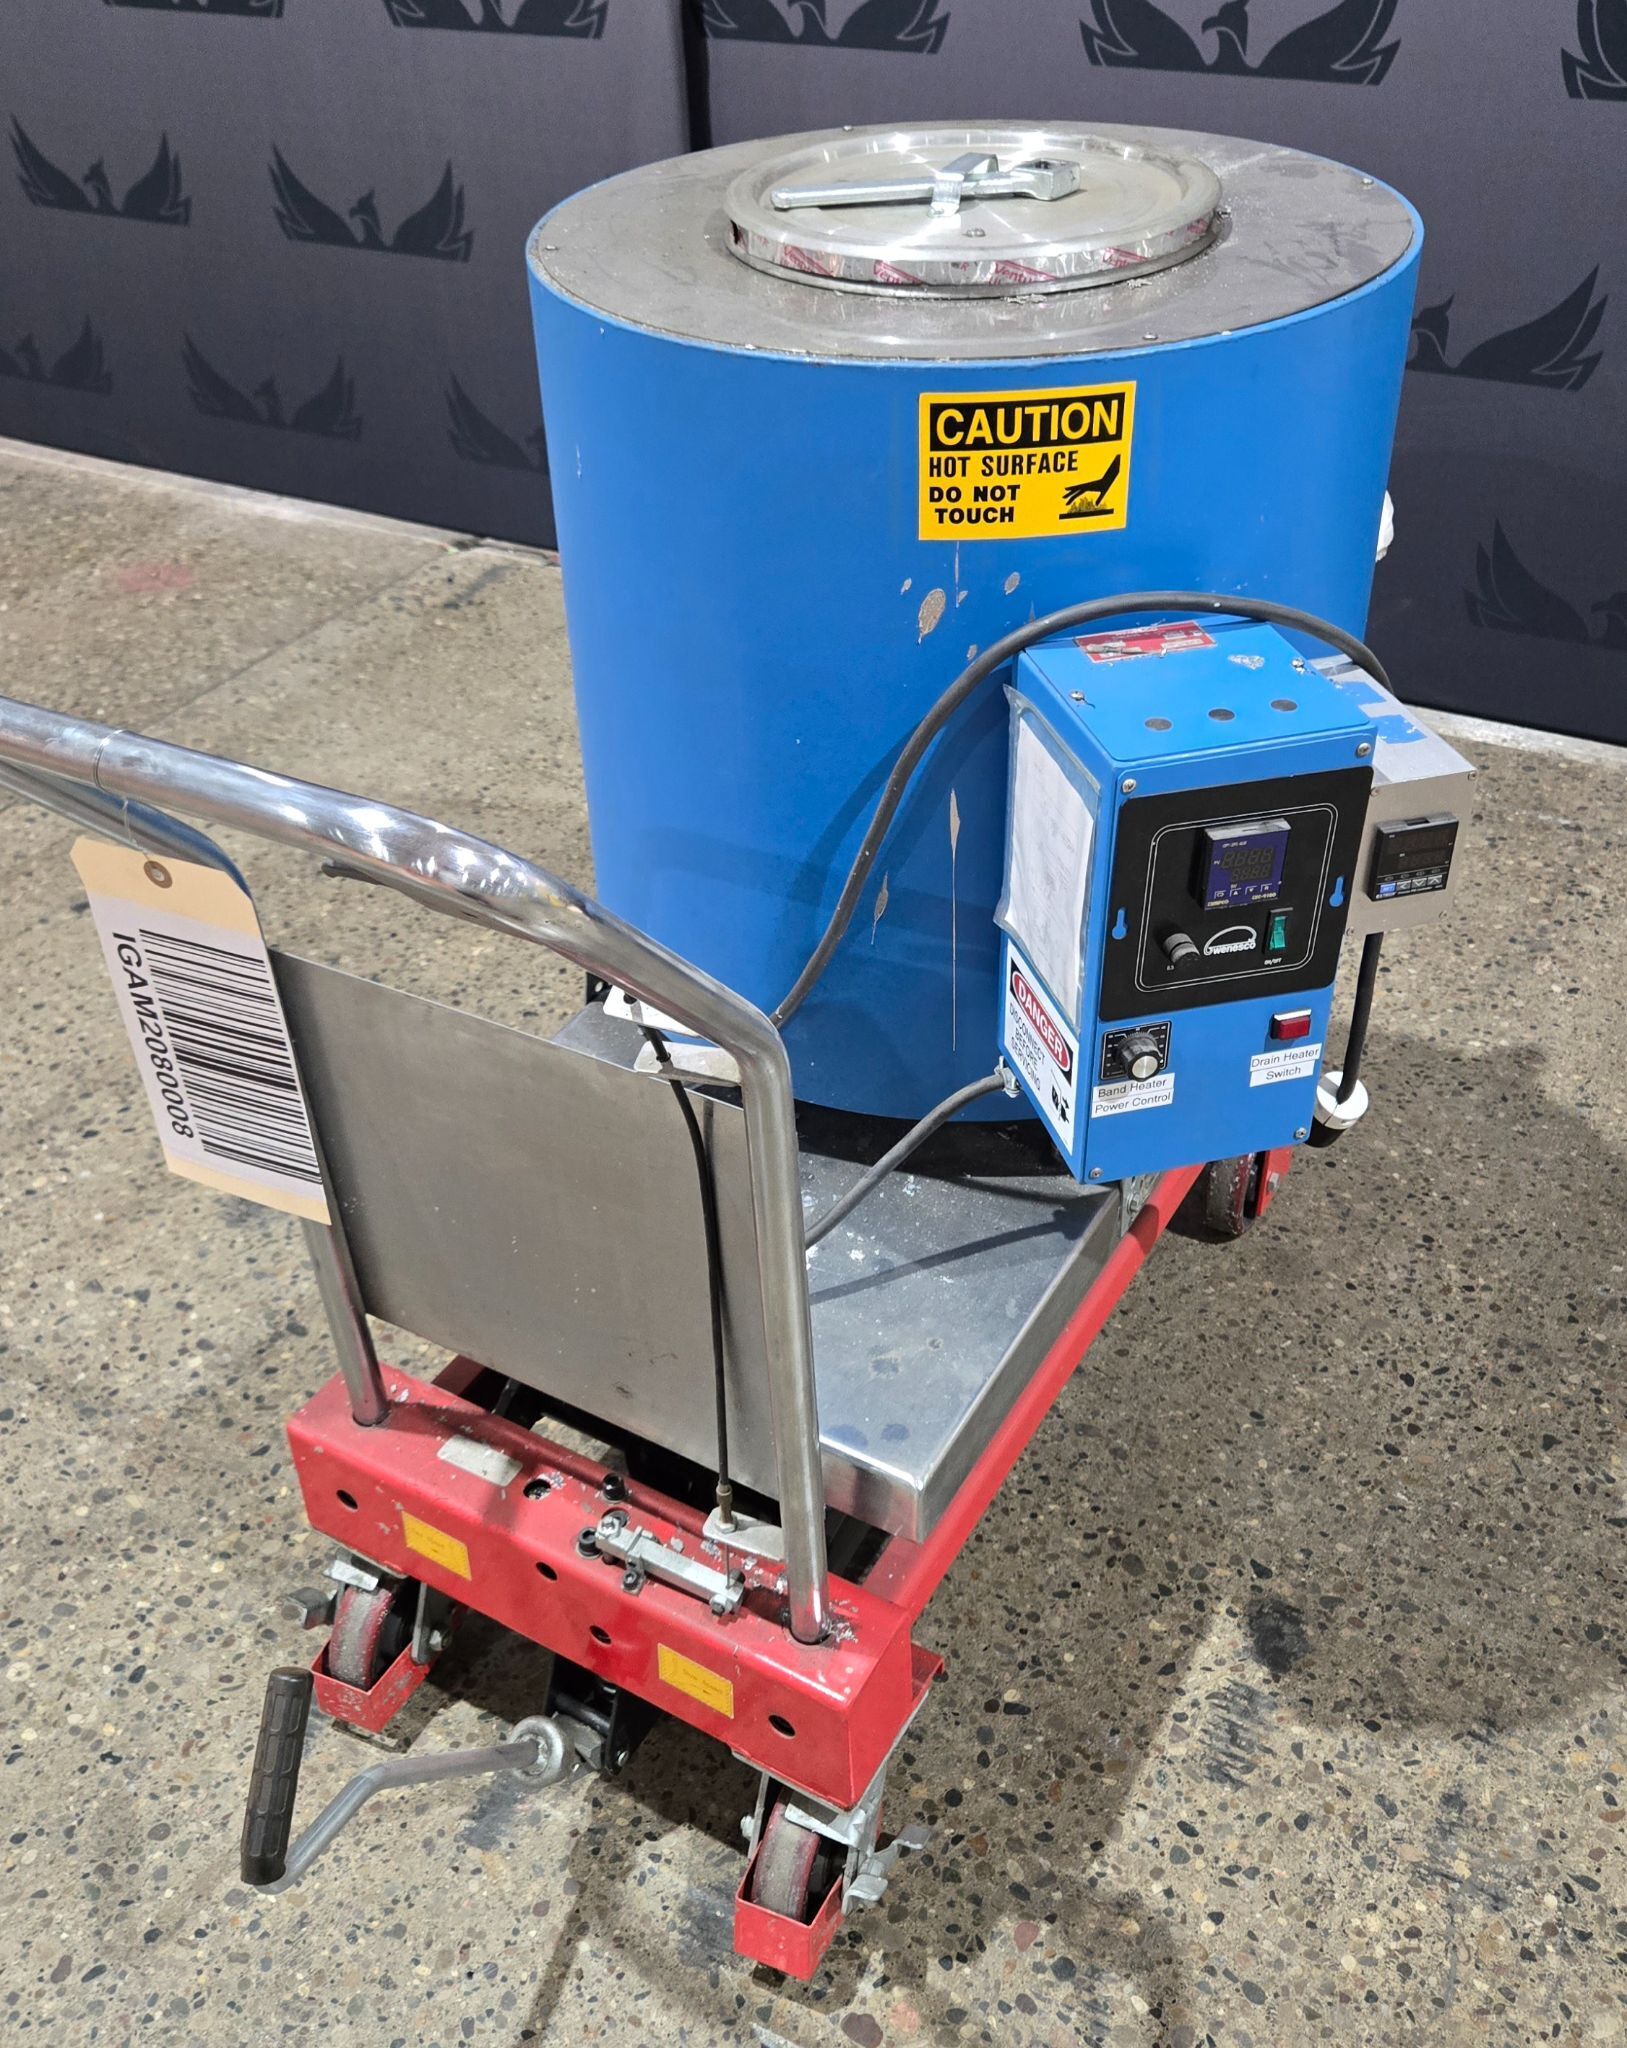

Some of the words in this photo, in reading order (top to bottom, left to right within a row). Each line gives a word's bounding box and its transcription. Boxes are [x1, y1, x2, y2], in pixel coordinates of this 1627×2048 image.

[936, 399, 1119, 446] CAUTION
[929, 456, 971, 478] HOT
[981, 450, 1079, 477] SURFACE
[929, 485, 962, 503] DO
[973, 484, 1021, 502] NOT
[934, 506, 1015, 525] TOUCH
[112, 931, 194, 1139] IGAM2080008
[1009, 1002, 1046, 1066] DISCONNECT
[1018, 981, 1064, 1061] DANGER
[1014, 1027, 1040, 1071] BEFORE
[1251, 1055, 1281, 1068] Drain
[1283, 1048, 1320, 1062] Heater
[1011, 1037, 1041, 1091] SERVICING
[1266, 1065, 1302, 1081] Switch
[1098, 1084, 1127, 1099] Band
[1130, 1078, 1168, 1093] Heater
[1095, 1100, 1128, 1114] Power
[1132, 1092, 1171, 1108] Control
